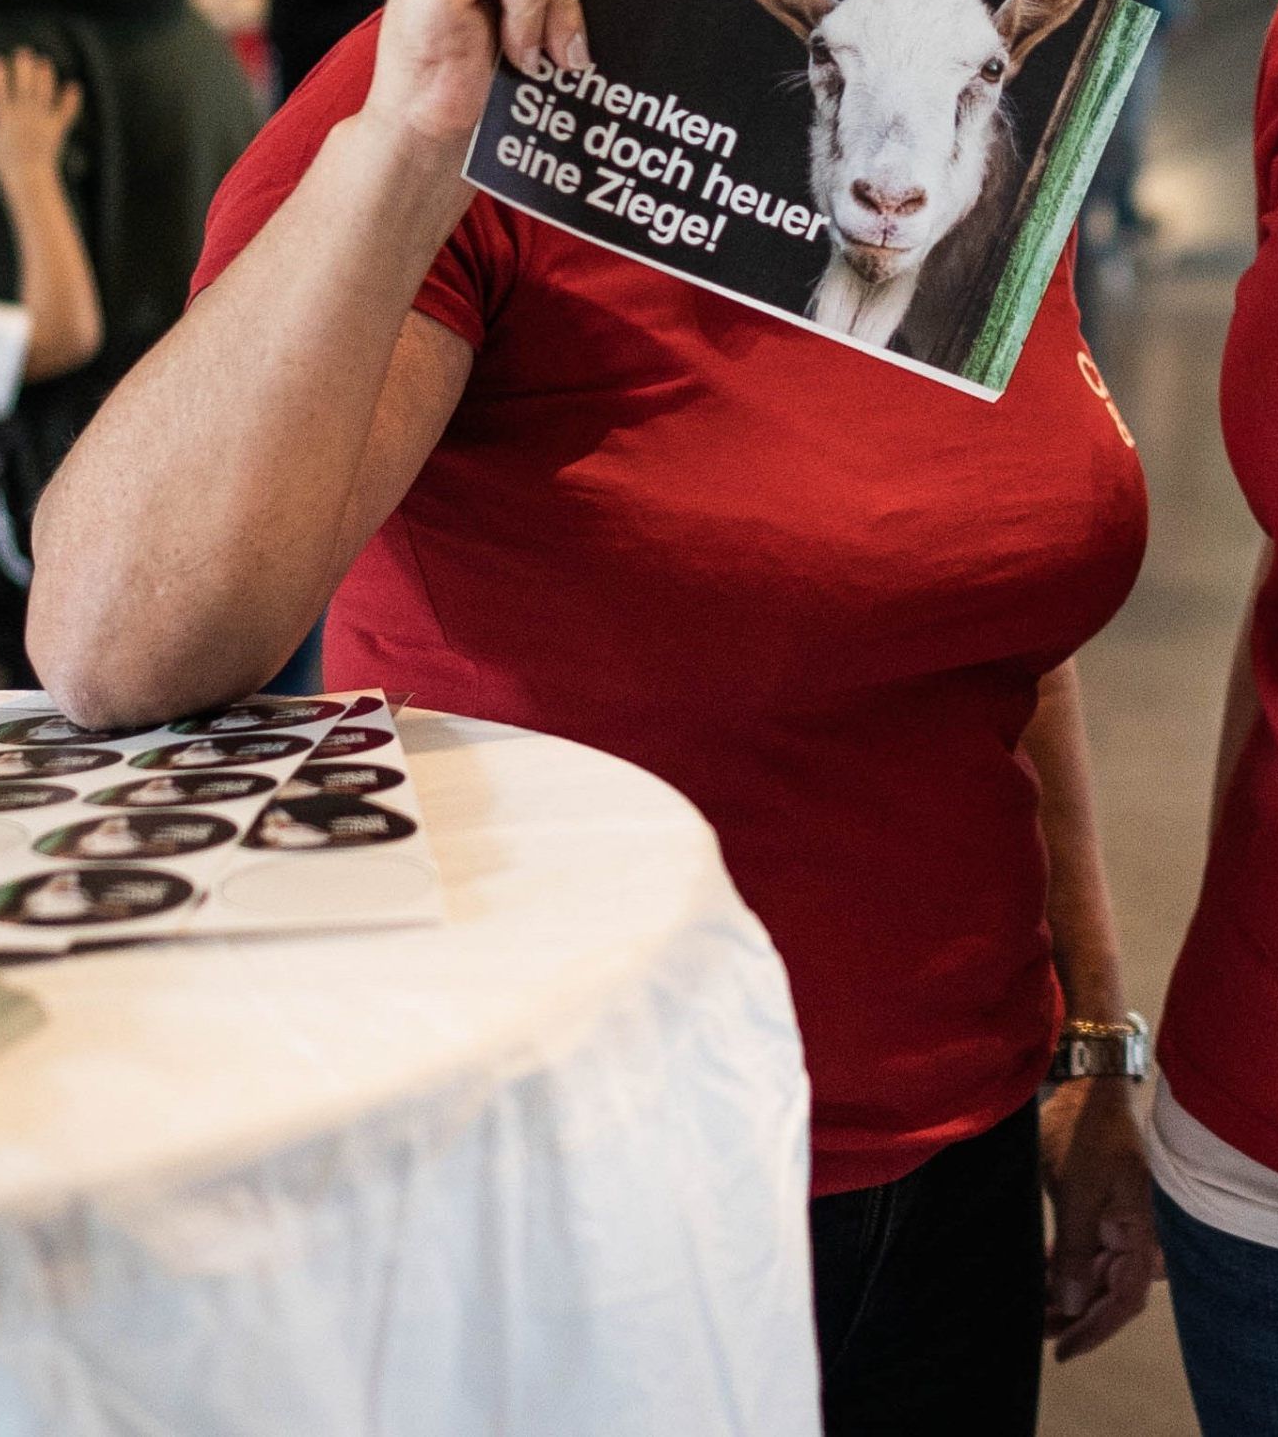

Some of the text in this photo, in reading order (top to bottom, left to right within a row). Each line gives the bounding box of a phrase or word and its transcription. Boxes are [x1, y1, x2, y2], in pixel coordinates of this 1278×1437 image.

[496, 134, 729, 253] eine Ziege!
[510, 83, 832, 242] Sie doch heuer
